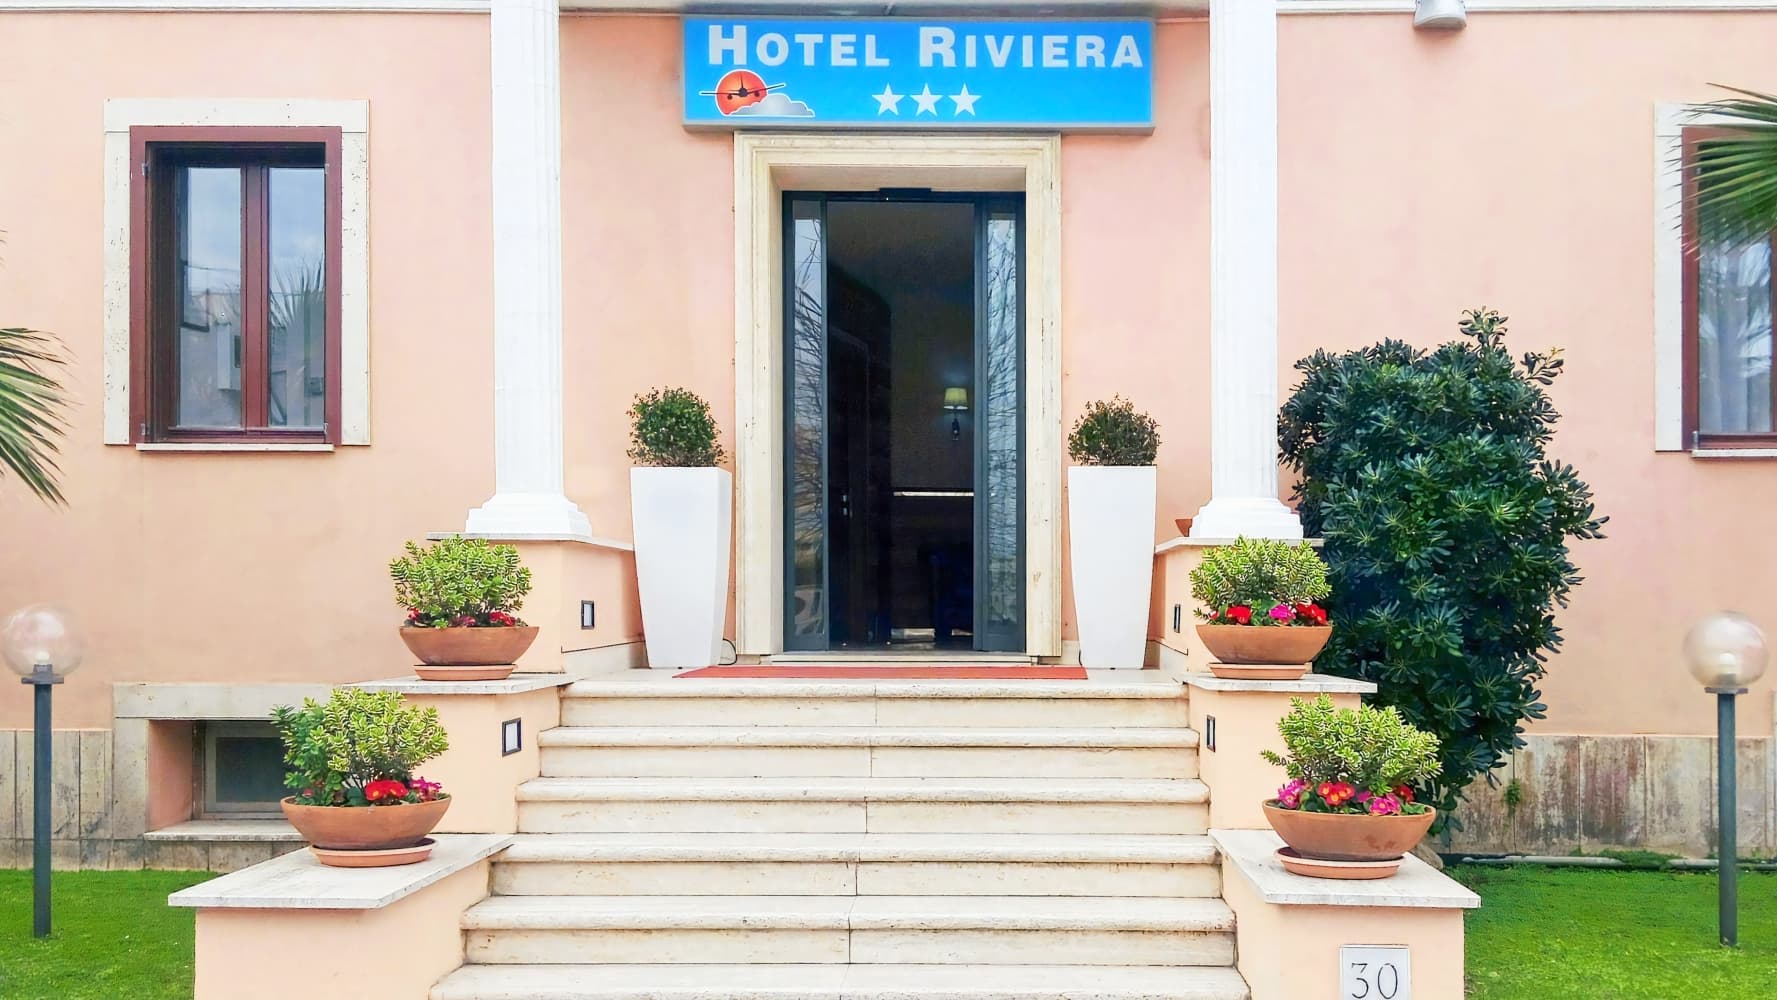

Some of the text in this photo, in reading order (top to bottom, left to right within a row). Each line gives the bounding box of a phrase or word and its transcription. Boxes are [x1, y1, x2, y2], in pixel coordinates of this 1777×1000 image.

[708, 24, 1144, 69] HOTEL RIVIERA
[1351, 962, 1398, 999] 30
